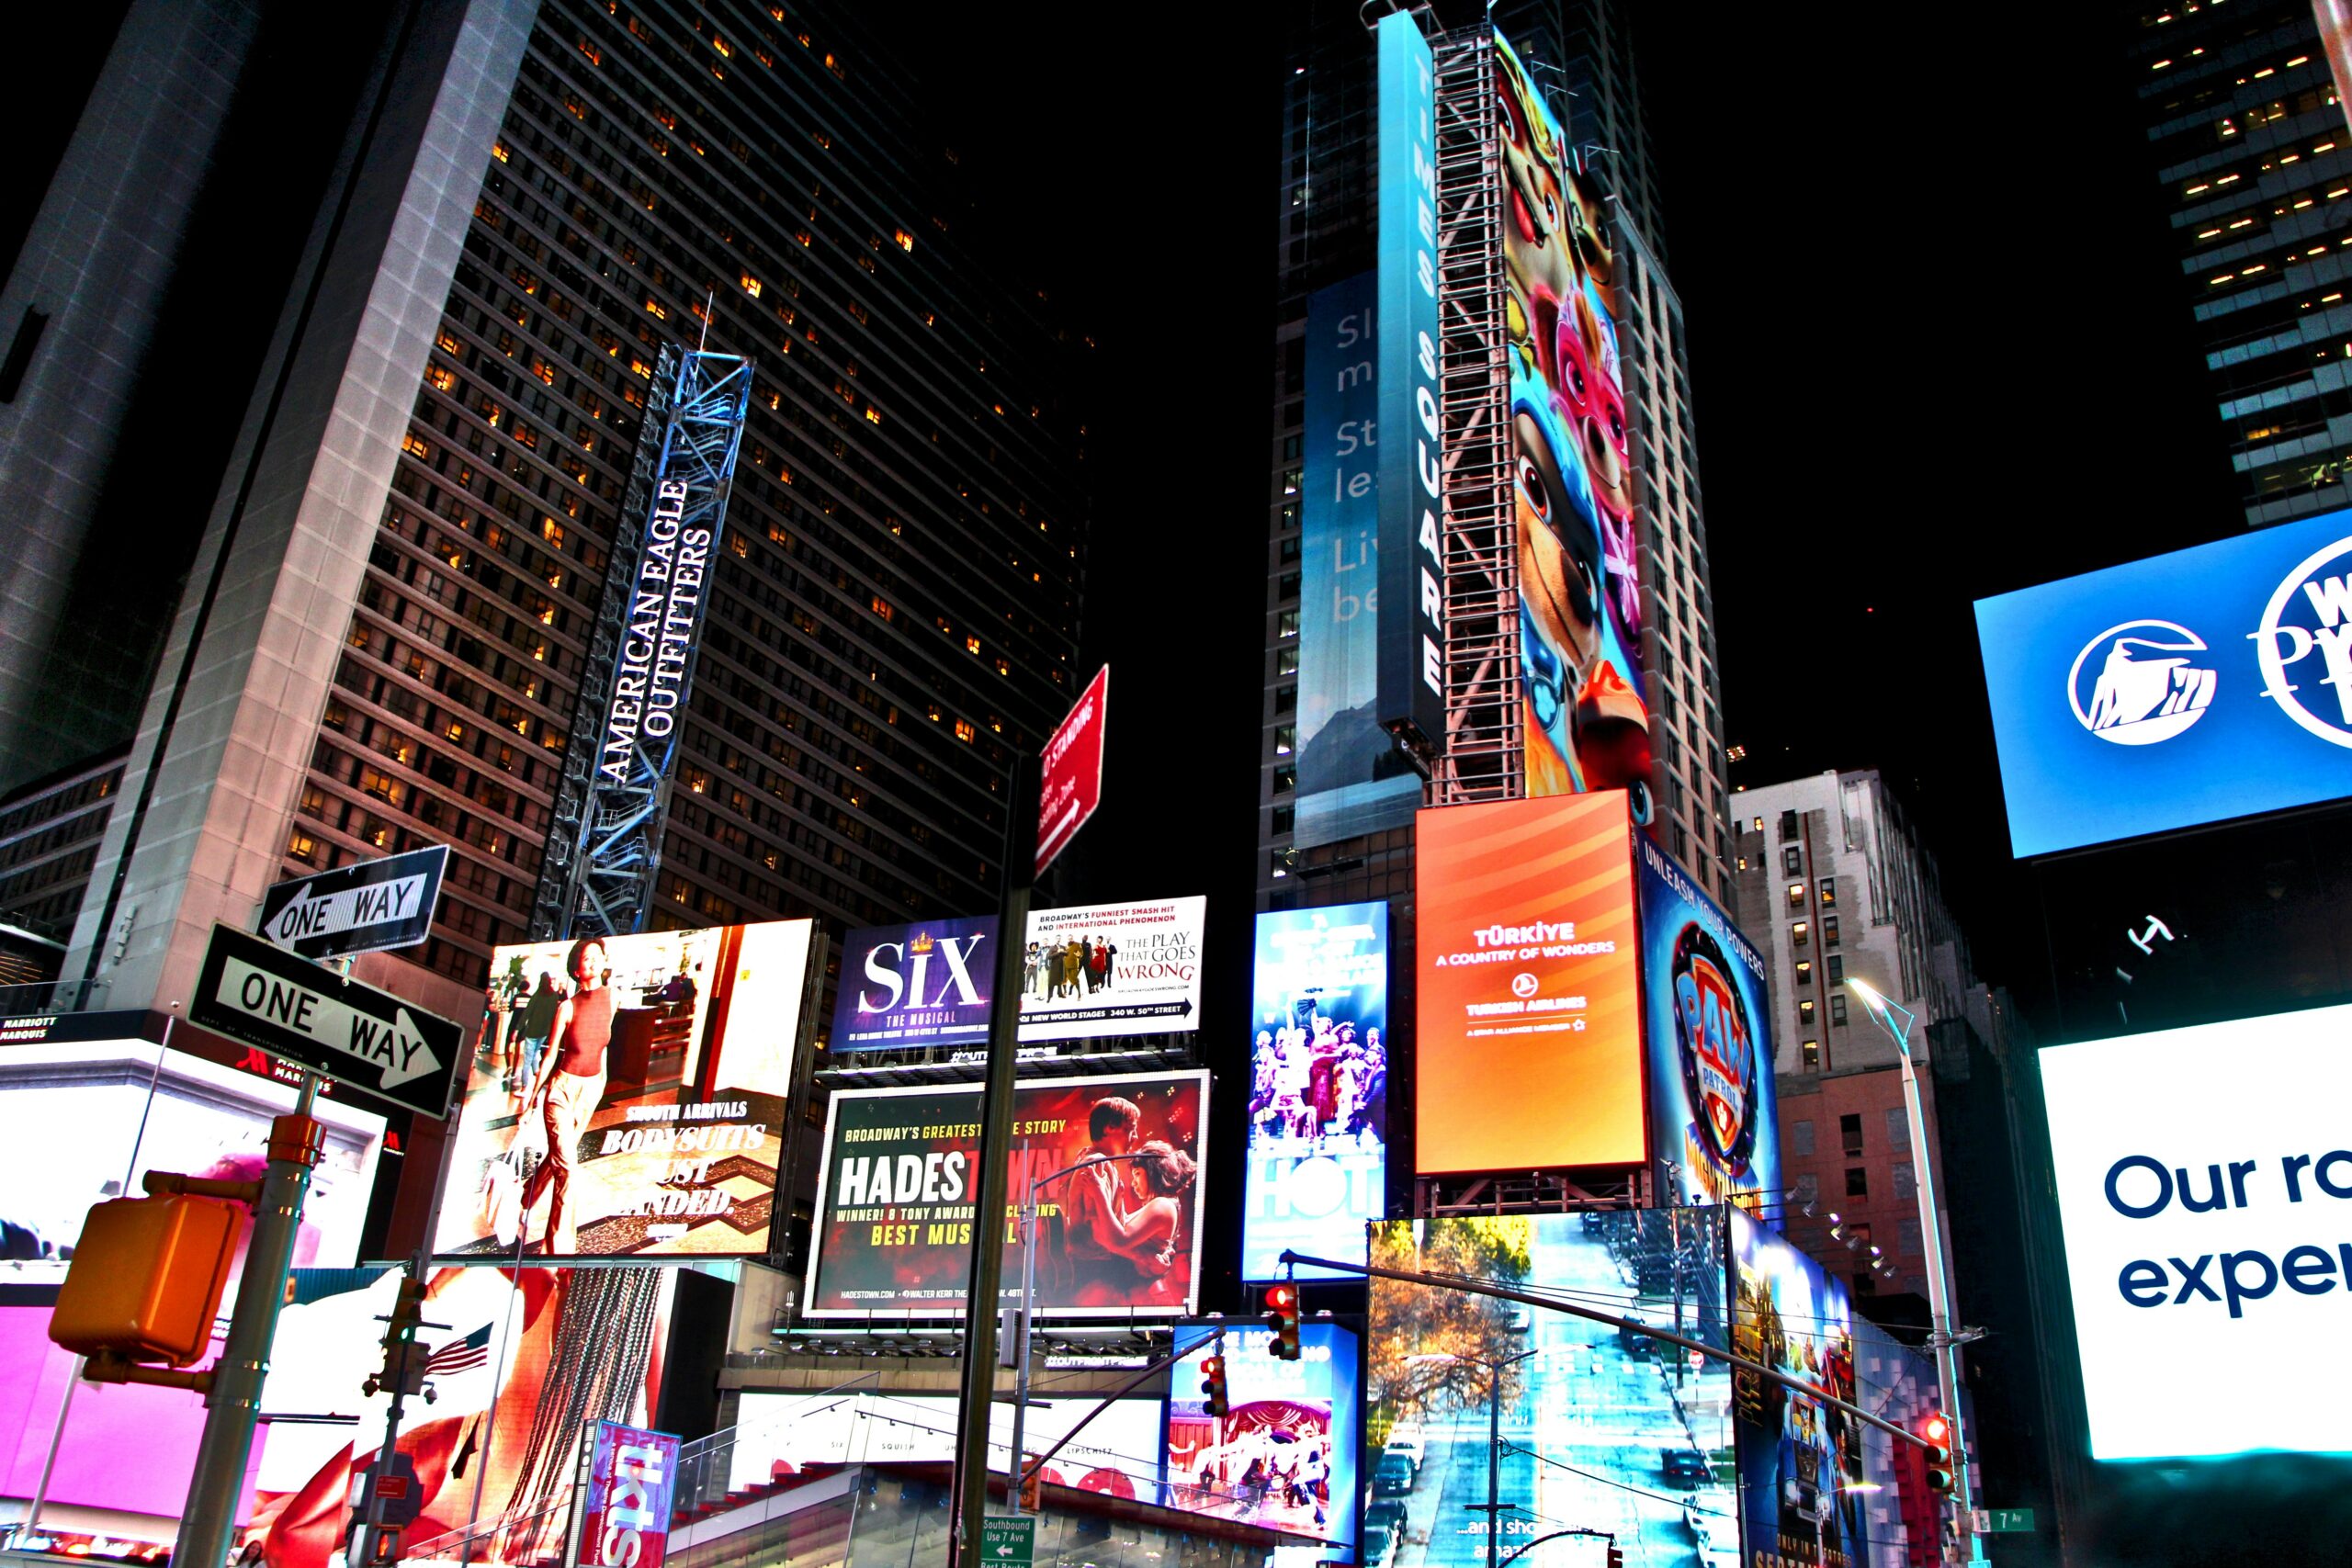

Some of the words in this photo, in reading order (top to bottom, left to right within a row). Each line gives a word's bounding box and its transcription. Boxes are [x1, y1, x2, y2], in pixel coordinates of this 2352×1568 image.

[1414, 52, 1435, 299] TIMES
[1416, 330, 1442, 697] SQUARE
[600, 591, 666, 784] AMERICAN
[641, 480, 688, 582] EAGLE
[643, 528, 711, 738] OUTFITTERS
[280, 898, 333, 940] ONE
[354, 881, 415, 925] WAY
[1040, 912, 1090, 923] BROADWAY'S
[1091, 909, 1129, 919] FUNNIEST
[1131, 907, 1159, 915] SMASH
[1057, 919, 1118, 930] INTERNATIONAL
[1120, 915, 1176, 925] PHENOMENON
[1645, 840, 1696, 909] UNLEASH
[1697, 896, 1724, 939] YOUR
[1725, 926, 1765, 981] POWERS
[1126, 938, 1148, 949] THE
[1151, 931, 1191, 947] PLAY
[1474, 920, 1576, 947] TÜRKİYE
[1119, 951, 1149, 962] THAT
[1151, 945, 1196, 963] GOES
[1435, 954, 1447, 966] A
[1449, 949, 1516, 965] COUNTRY
[1519, 947, 1540, 960] OF
[1542, 941, 1616, 958] WONDERS
[857, 933, 987, 1014] SIX
[1117, 962, 1195, 981] WRONG
[4, 1017, 58, 1028] MARRIOTT
[241, 972, 320, 1034] ONE
[349, 1014, 423, 1073] WAY
[886, 1014, 906, 1027] THE
[910, 1011, 956, 1026] MUSICAL
[1032, 1013, 1049, 1022] NEW
[1050, 1011, 1077, 1021] WORLD
[1079, 1010, 1105, 1020] STAGES
[1110, 1009, 1125, 1017] 340
[1126, 1008, 1136, 1016] W.
[1155, 1006, 1182, 1014] STREET
[0, 1029, 49, 1040] MARQUIS
[1676, 971, 1752, 1095] PAW
[1702, 1066, 1739, 1112] PATROL
[683, 1101, 747, 1120] ARRIVALS
[600, 1123, 767, 1155] BODYSUITS
[844, 1127, 919, 1143] BROADWAY'S
[922, 1123, 982, 1139] GREATEST
[1025, 1120, 1066, 1134] STORY
[838, 1148, 1064, 1206] HADESTWN
[1250, 1155, 1380, 1217] HOT
[2104, 1155, 2256, 1219] Our
[837, 1208, 884, 1222] WINNER!
[888, 1208, 896, 1220] 8
[900, 1207, 930, 1220] TONY
[934, 1206, 976, 1219] AWARD
[871, 1224, 920, 1247] BEST
[841, 1290, 895, 1299] HADESTOWN.COM
[910, 1290, 935, 1298] WALTER
[936, 1290, 954, 1298] KERR
[602, 1443, 663, 1567] tkts
[984, 1519, 1030, 1530] Southbound
[1999, 1513, 2007, 1529] 7
[987, 1531, 1000, 1541] Use
[1002, 1531, 1008, 1542] 7
[1010, 1532, 1024, 1542] Ave
[1777, 1533, 1797, 1551] ONLY
[1801, 1540, 1809, 1555] IN
[1813, 1544, 1852, 1567] TEATRES
